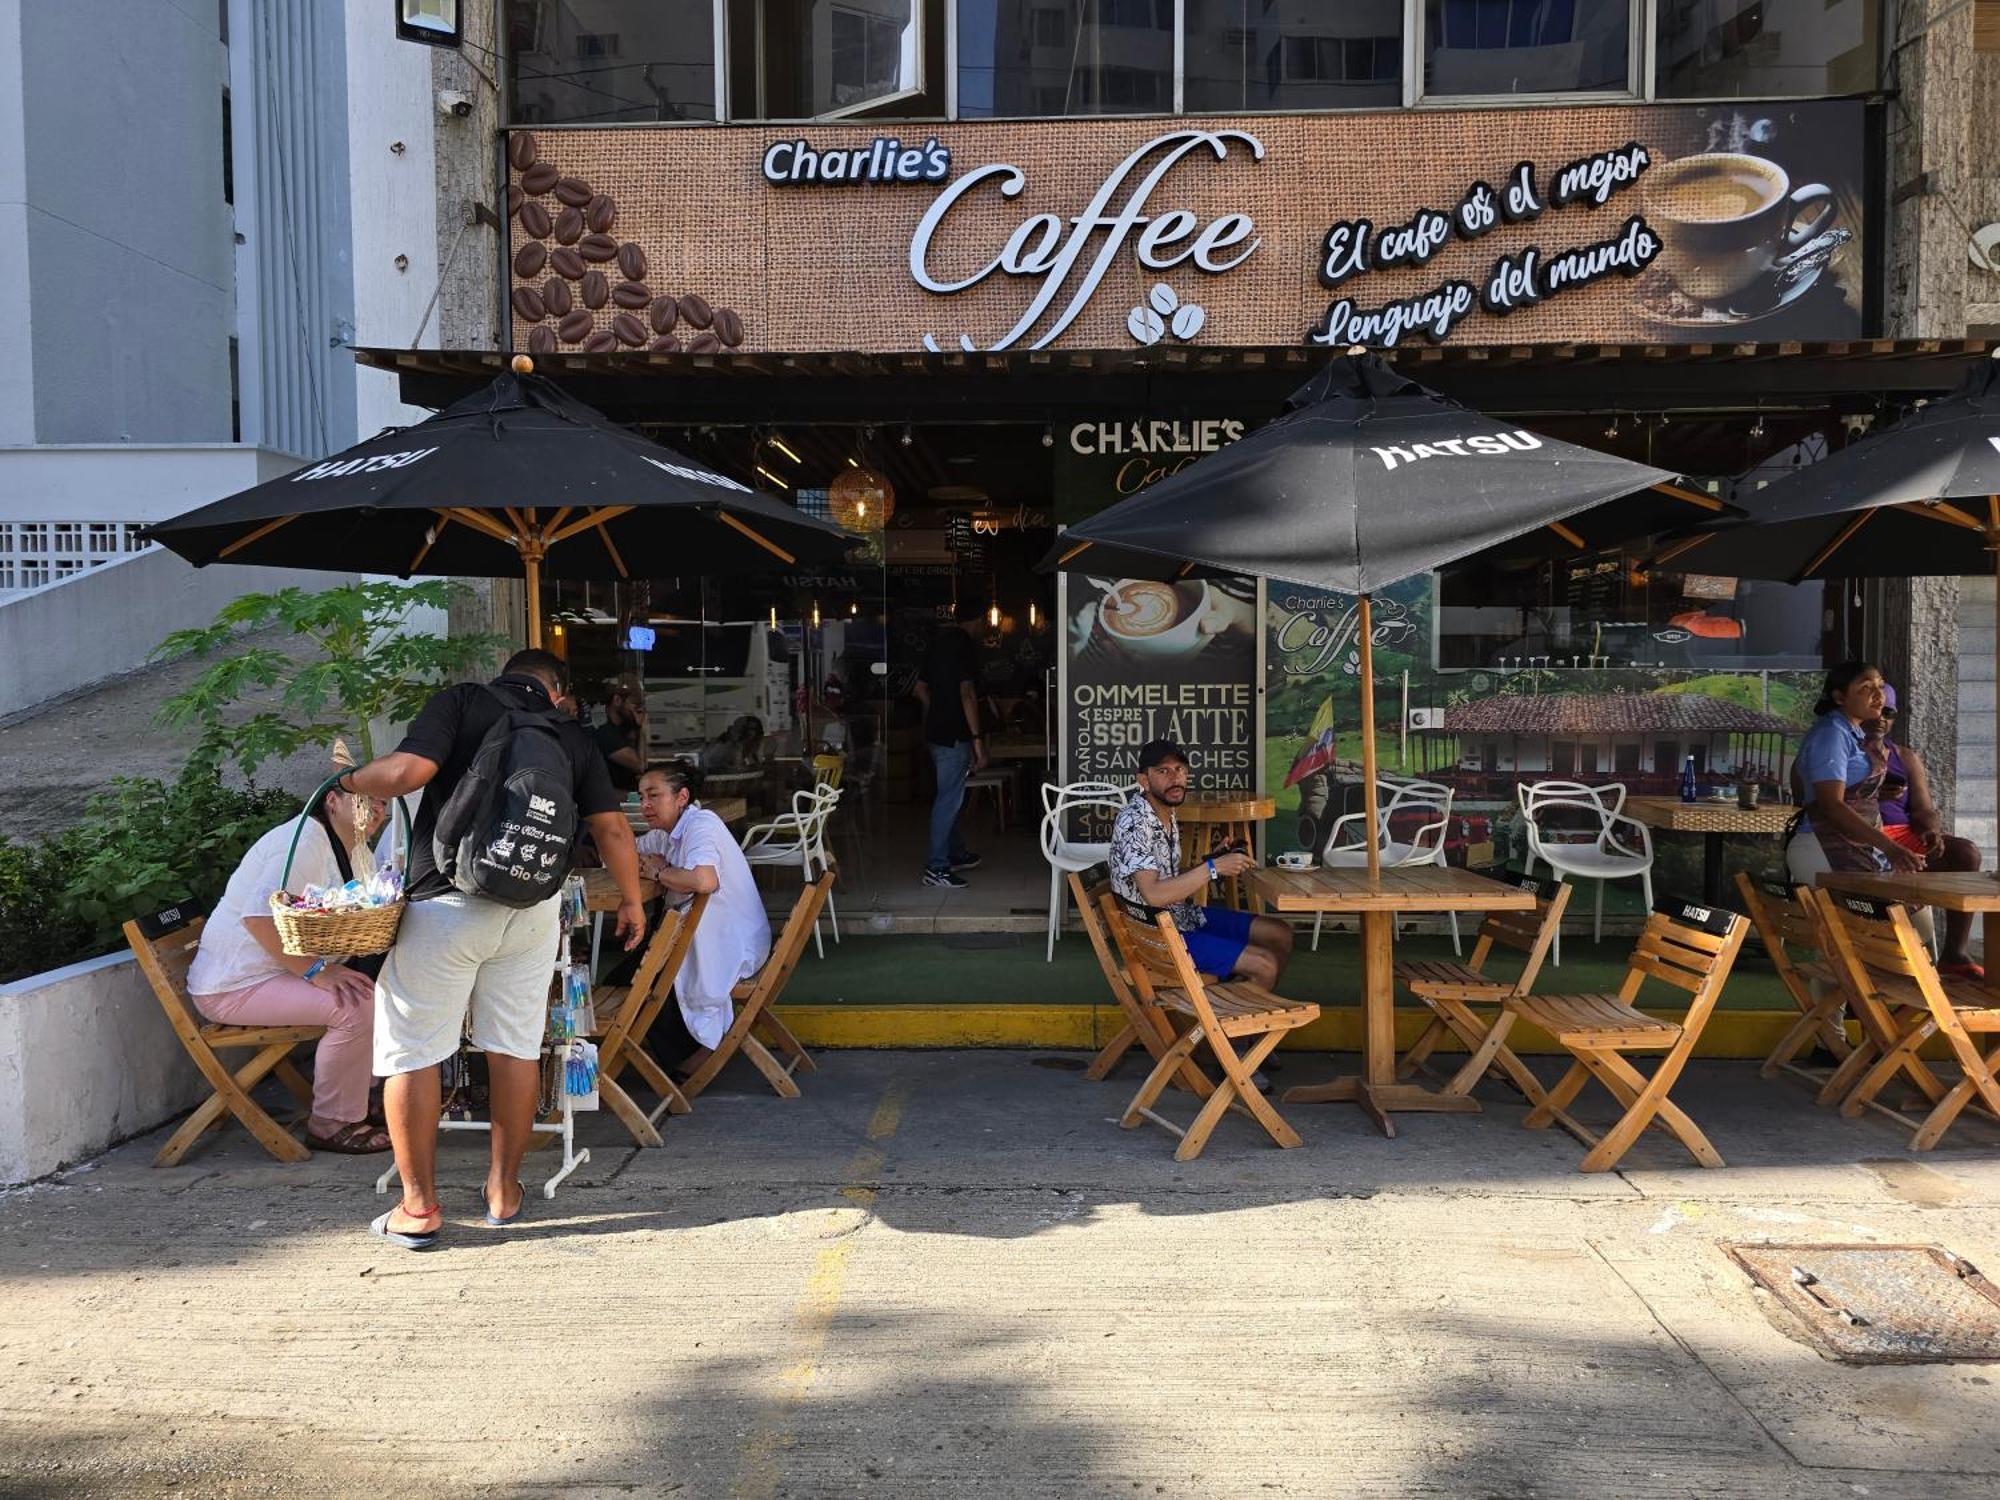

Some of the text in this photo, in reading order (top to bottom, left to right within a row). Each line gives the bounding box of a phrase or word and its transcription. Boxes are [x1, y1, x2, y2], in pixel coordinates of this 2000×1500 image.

[763, 136, 950, 183] Charlie's
[1325, 146, 1649, 278] El cafe es el mejor
[908, 129, 1266, 352] Coffee
[1312, 221, 1658, 347] Lenguaje del mundo
[290, 445, 440, 483] HATSU
[1368, 429, 1544, 471] HATSU
[1073, 683, 1251, 706] OMMELETTE
[1093, 708, 1143, 722] ESPRE
[1145, 708, 1250, 746] LATTE
[1093, 723, 1143, 746] SSO
[1200, 774, 1250, 789] CHAI
[528, 794, 556, 816] BIG
[1681, 904, 1712, 923] HATSU
